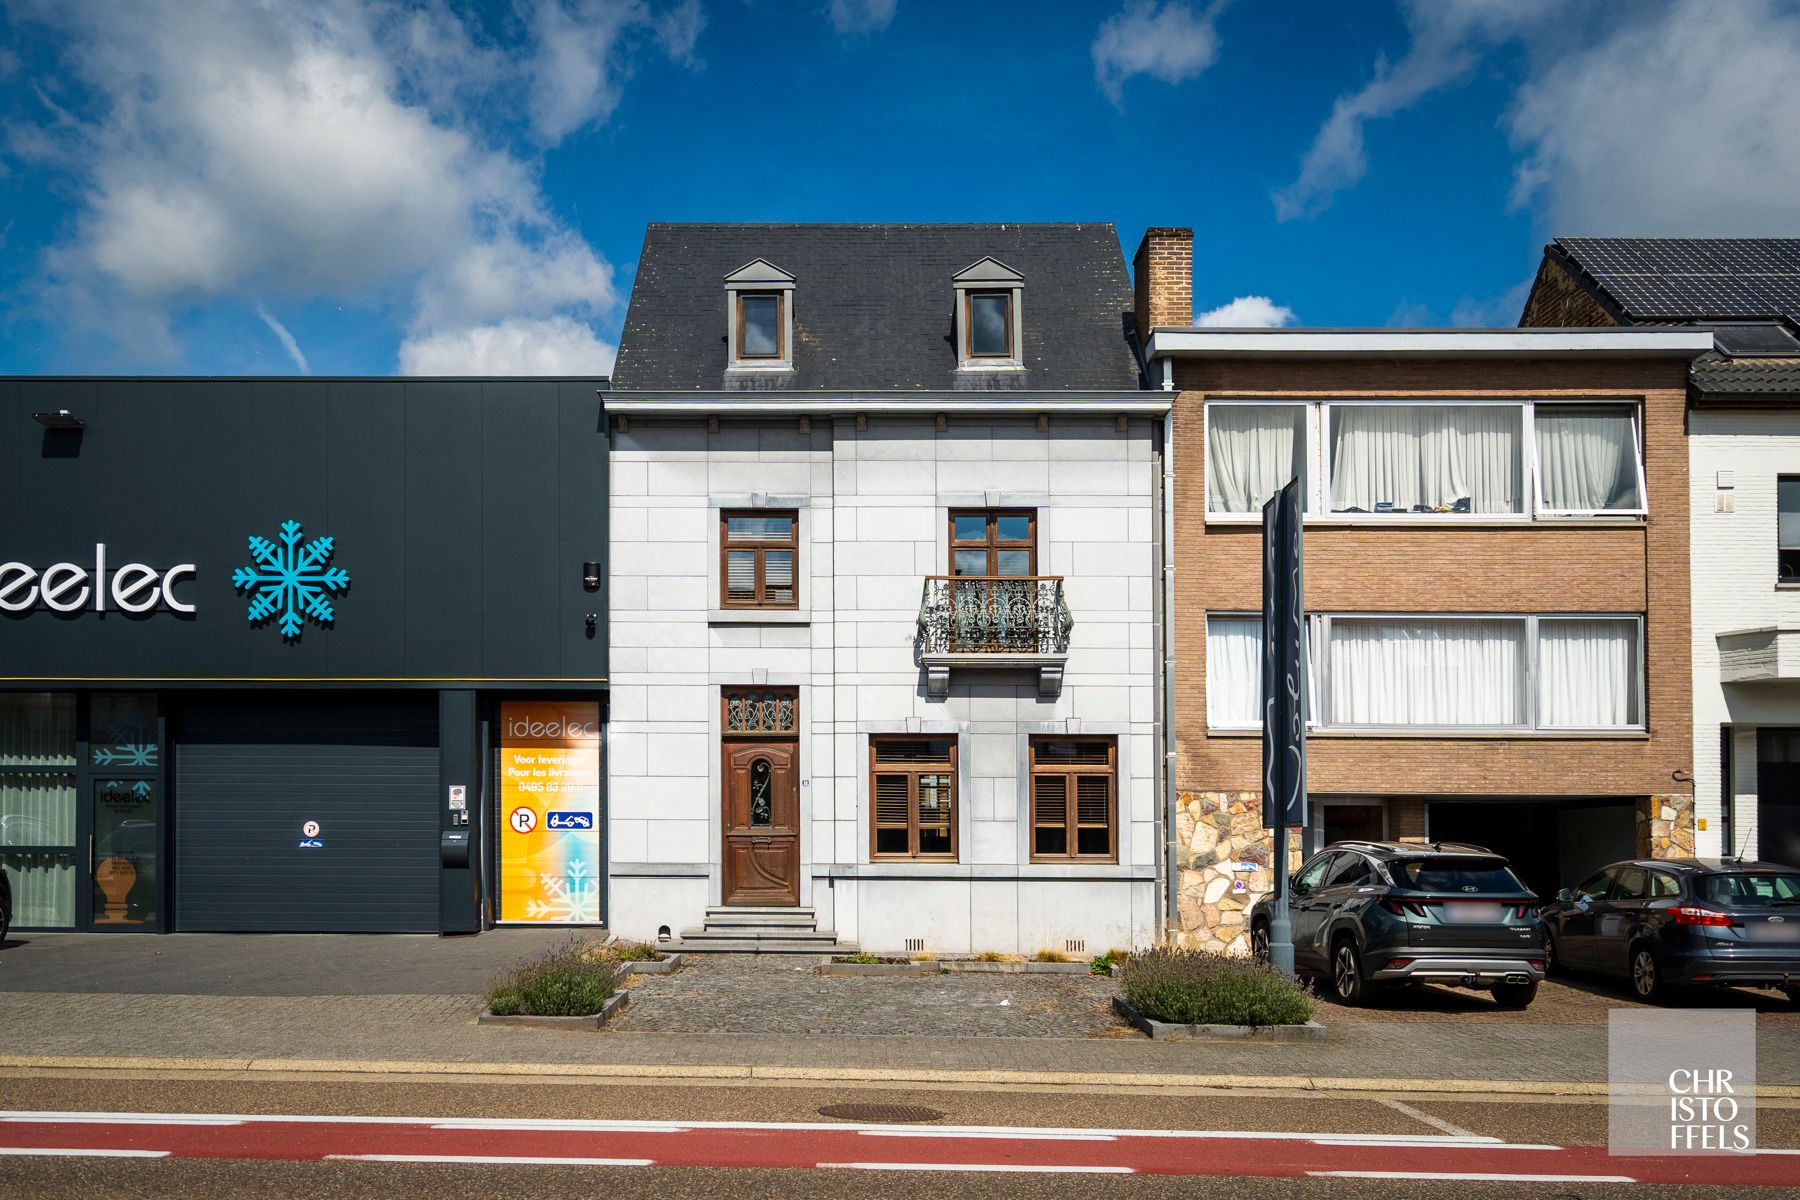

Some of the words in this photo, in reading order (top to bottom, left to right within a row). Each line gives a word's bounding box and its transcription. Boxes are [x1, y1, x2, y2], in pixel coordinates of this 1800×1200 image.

[0, 543, 197, 612] eelec
[509, 715, 594, 738] ideelec
[513, 754, 536, 764] Voor
[508, 767, 531, 777] Pour
[533, 767, 546, 777] les
